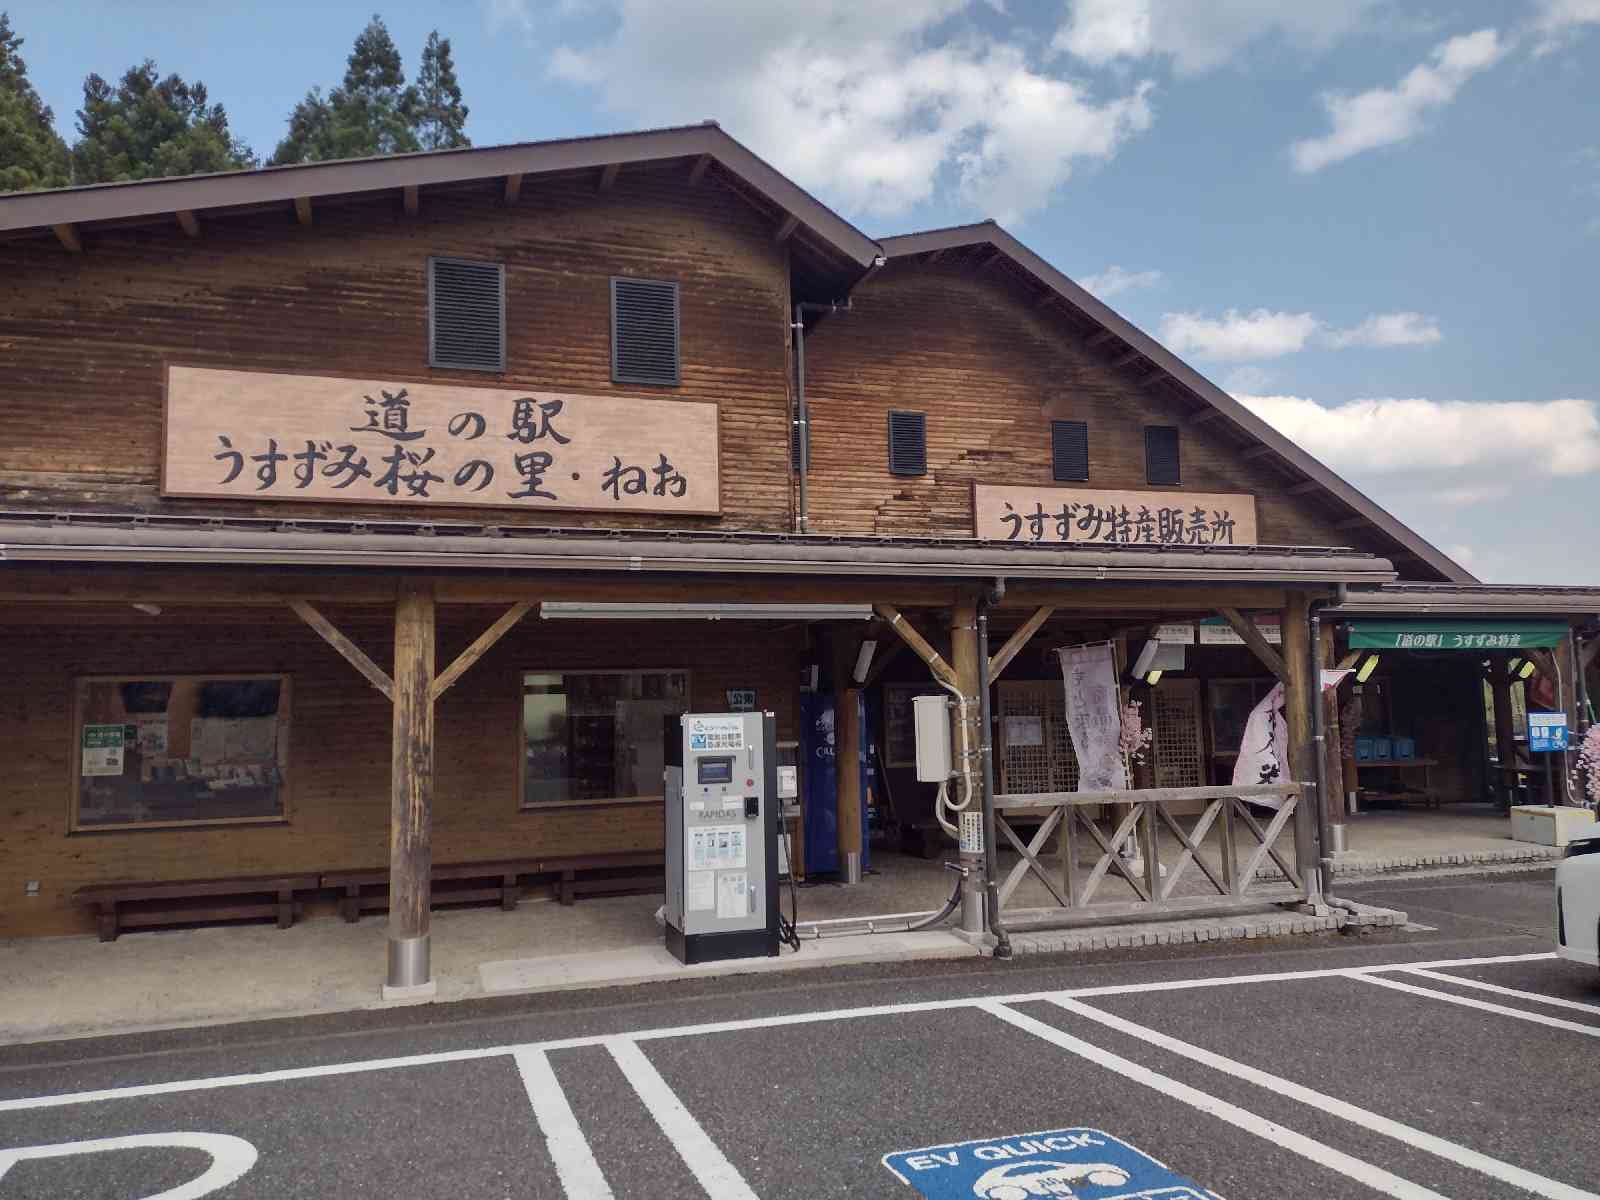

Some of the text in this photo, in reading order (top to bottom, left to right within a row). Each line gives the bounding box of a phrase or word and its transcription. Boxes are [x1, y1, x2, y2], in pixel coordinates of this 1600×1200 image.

[350, 389, 570, 444] 道の駅
[213, 436, 688, 500] うすずみ桜の里・ねお
[1000, 502, 1236, 545] うすずみ特産販売所
[906, 1133, 1105, 1170] EV QUICK
